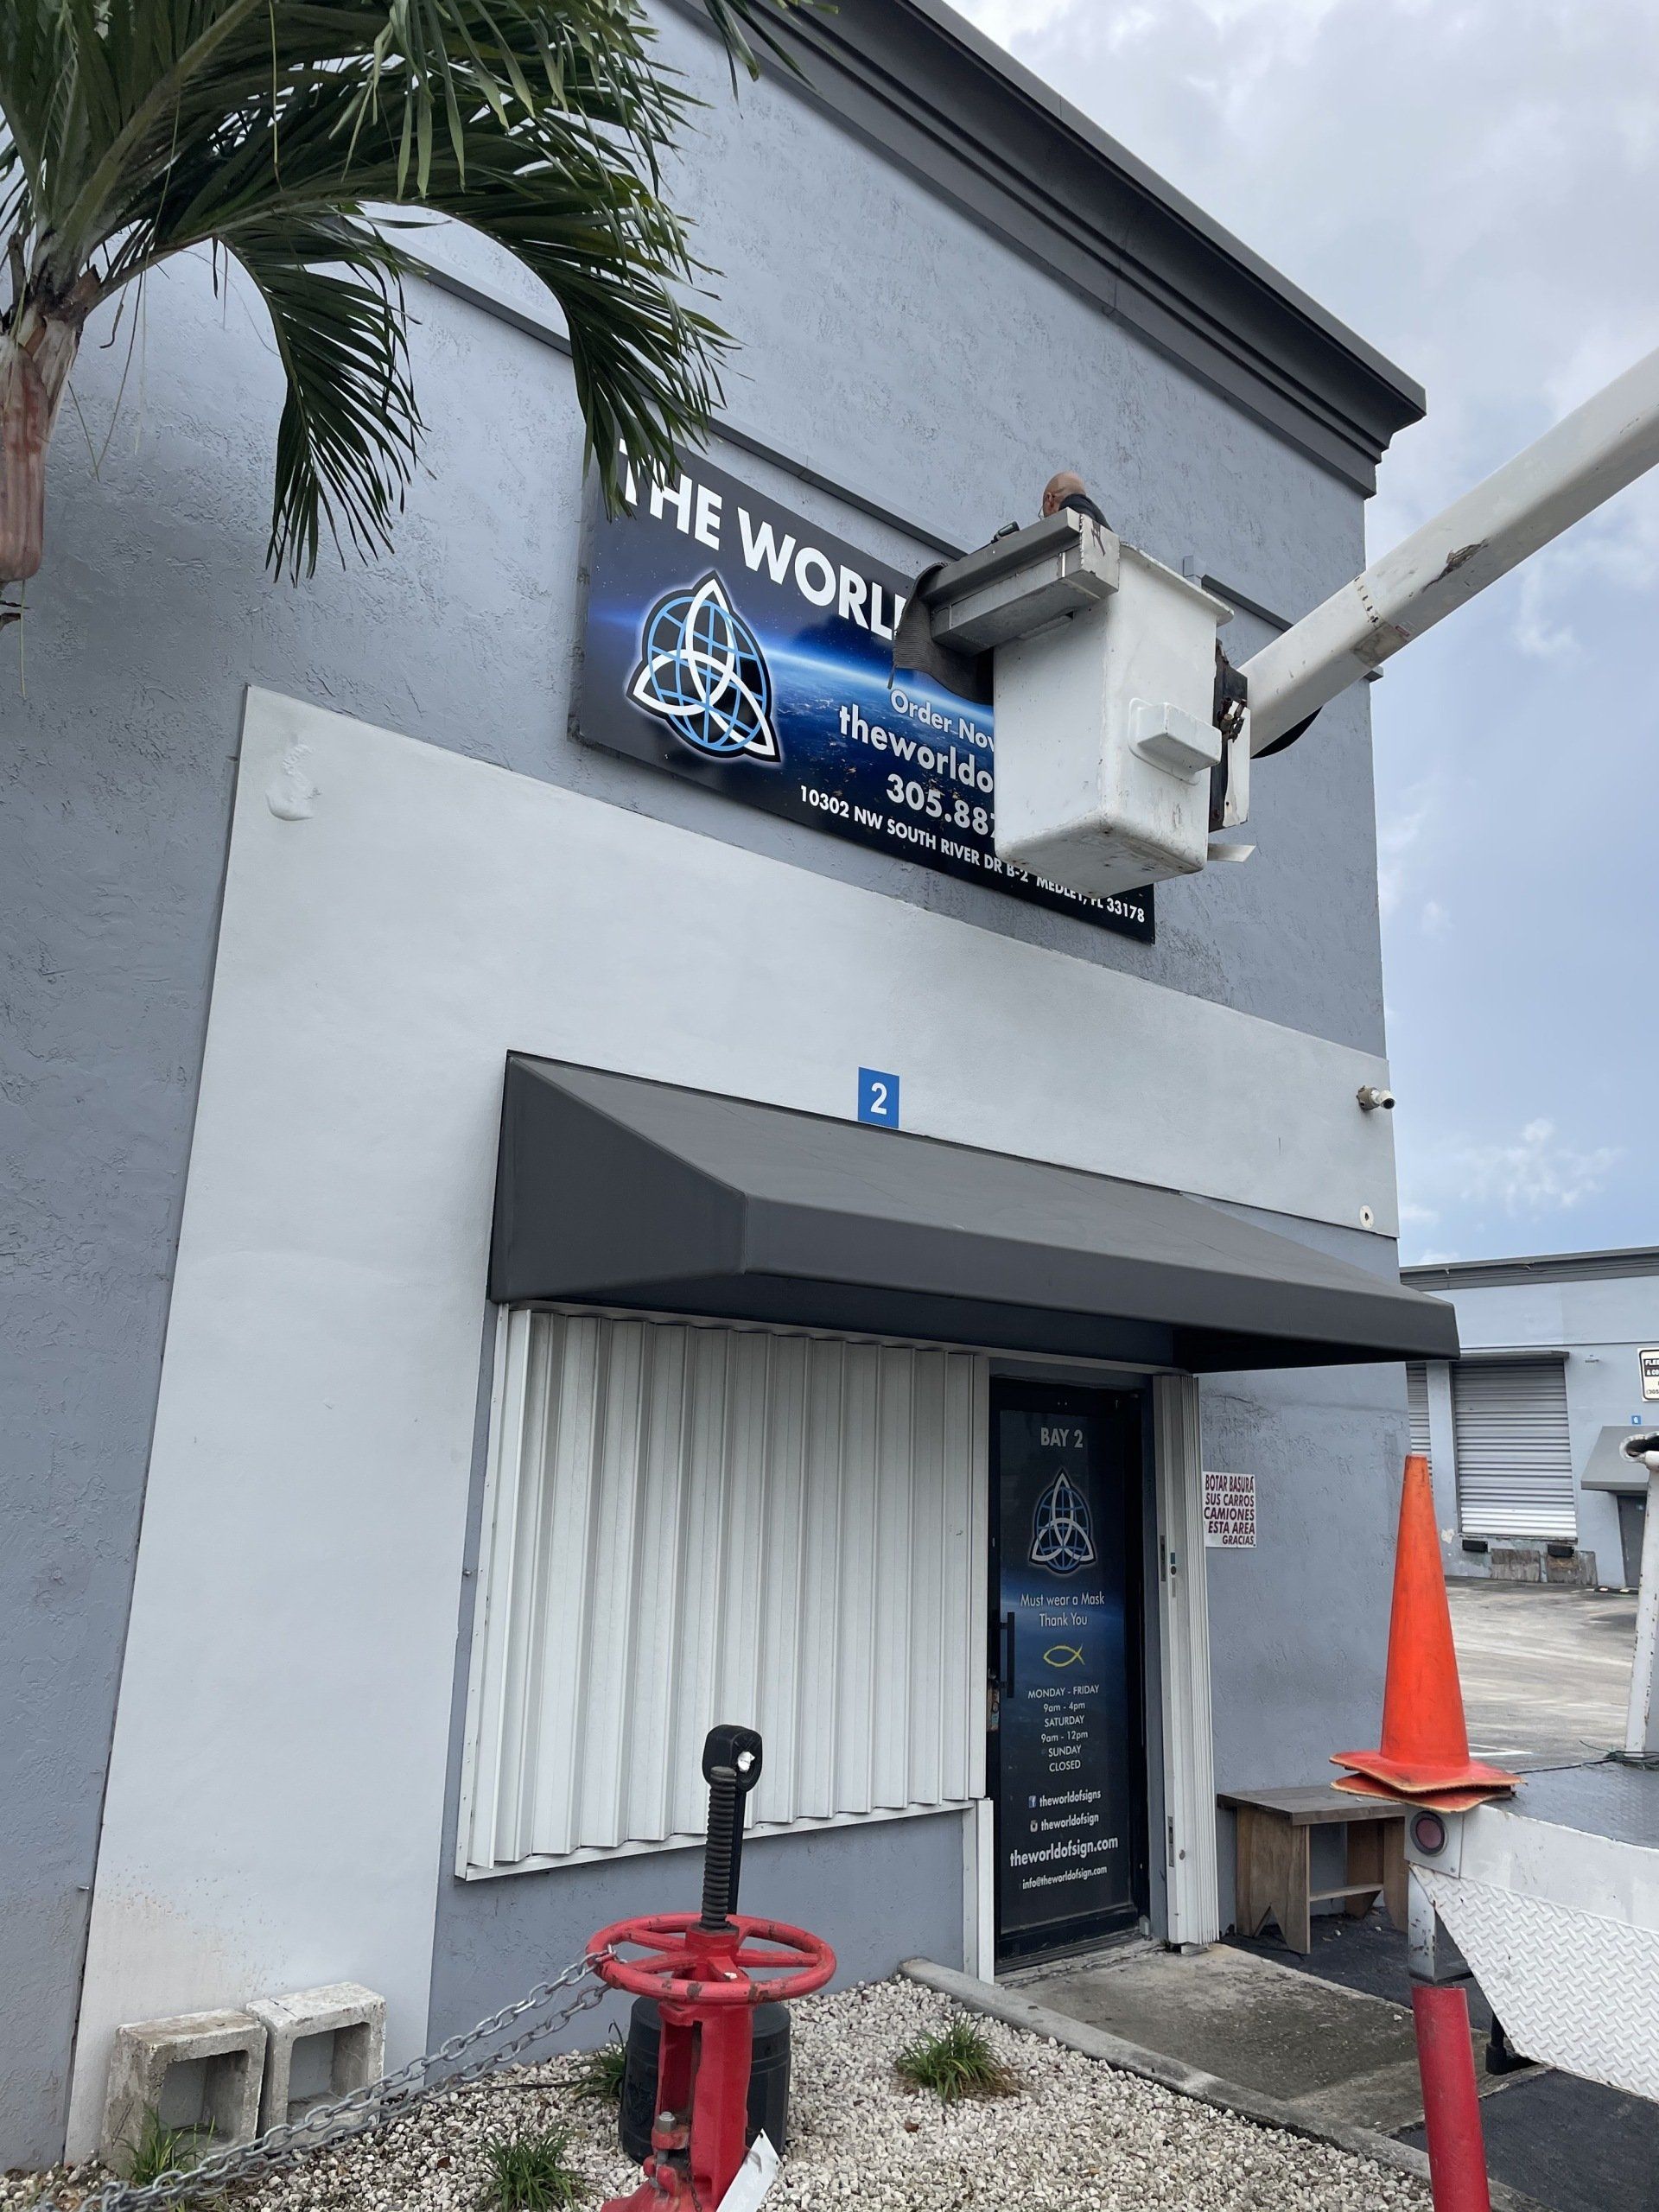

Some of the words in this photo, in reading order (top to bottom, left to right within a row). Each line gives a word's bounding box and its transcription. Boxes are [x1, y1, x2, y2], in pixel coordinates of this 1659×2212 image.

[620, 438, 722, 550] THE
[891, 689, 952, 733] Order
[839, 703, 995, 793] theworldo
[886, 773, 995, 838] 305.88
[800, 785, 849, 817] 10302
[854, 805, 883, 830] NW
[887, 818, 937, 850] SOUTH
[941, 838, 980, 866] RIVER
[984, 853, 1002, 874] DR
[1007, 863, 1029, 883] B-2
[1106, 897, 1145, 923] 33178
[870, 1082, 887, 1115] 2
[1040, 1427, 1070, 1447] BAY
[1074, 1429, 1084, 1448] 2
[1205, 1474, 1228, 1491] BOTAR
[1229, 1476, 1255, 1493] BASURA
[1205, 1493, 1221, 1505] SUS
[1224, 1494, 1255, 1507] CARROS
[1204, 1506, 1255, 1521] CAMIONES
[1208, 1521, 1230, 1534] ESTA
[1232, 1522, 1255, 1535] AREA
[1020, 1593, 1044, 1607] Must
[1046, 1595, 1070, 1606] wear
[1072, 1596, 1078, 1605] a
[1081, 1591, 1105, 1605] Mask
[1039, 1612, 1068, 1627] Thank
[1071, 1612, 1088, 1625] You
[1027, 1687, 1065, 1699] MONDAY
[1072, 1684, 1099, 1695] FRIDAY
[1043, 1703, 1061, 1713] 9am
[1068, 1701, 1085, 1712] 4pm
[1044, 1715, 1084, 1727] SATURDAY
[1040, 1733, 1058, 1743] 9am
[1067, 1730, 1089, 1741] 12pm
[1048, 1745, 1082, 1758] SUNDAY
[1049, 1759, 1081, 1772] CLOSED
[1039, 1789, 1101, 1808] theworldofsigns
[1040, 1812, 1099, 1831] theworldofsign
[1009, 1837, 1118, 1866] theworldofsign.com
[1022, 1866, 1107, 1890] info@theworldofsign.com
